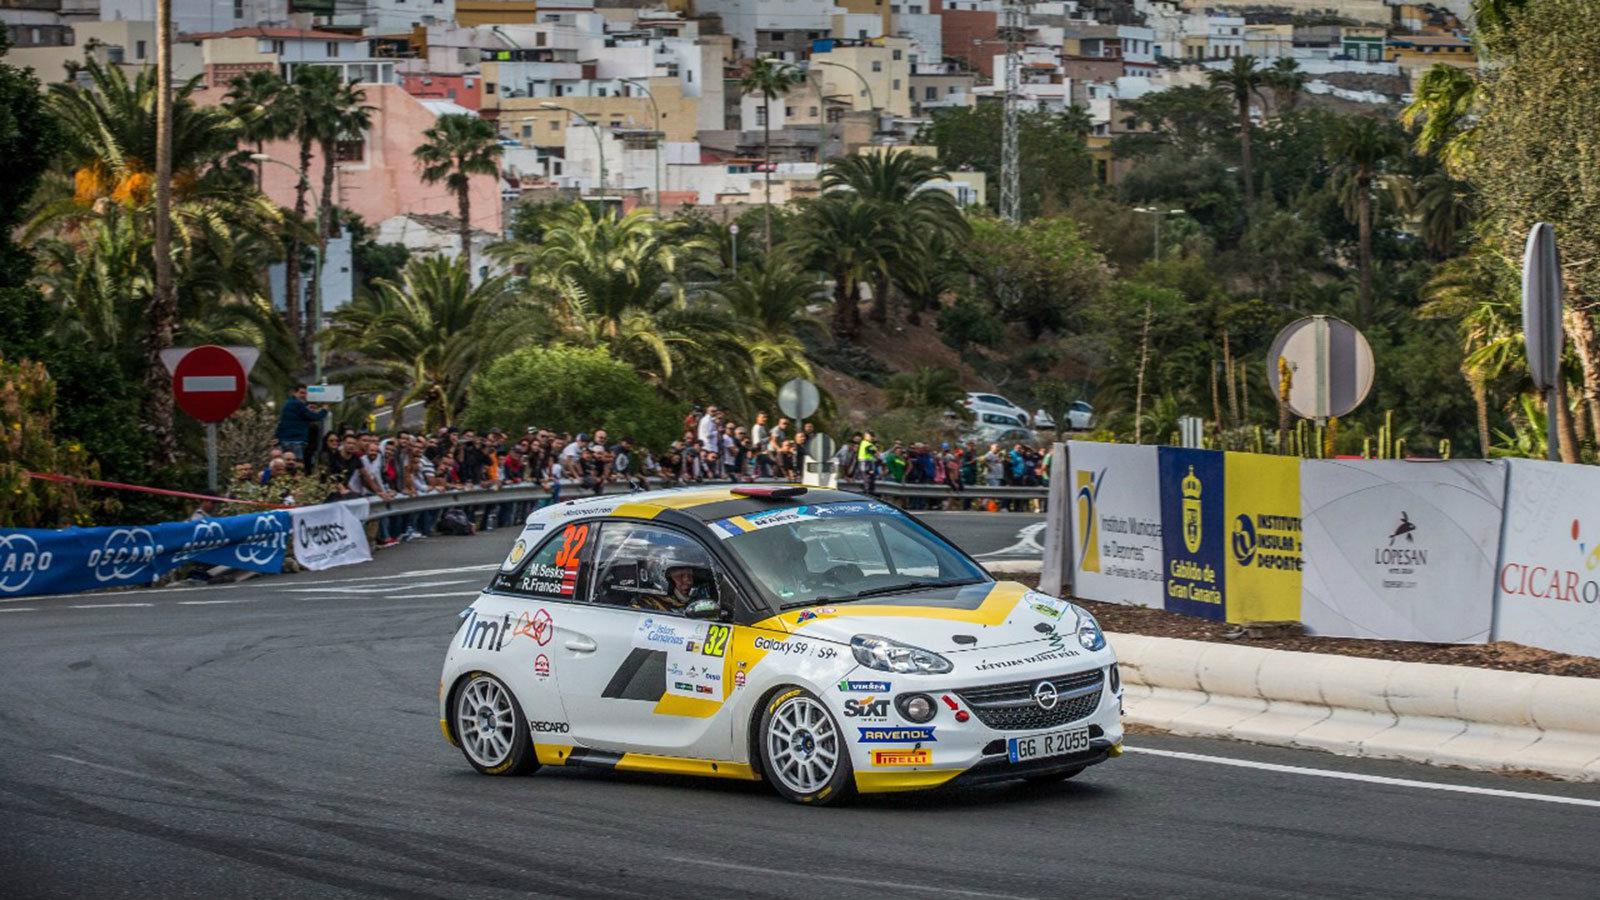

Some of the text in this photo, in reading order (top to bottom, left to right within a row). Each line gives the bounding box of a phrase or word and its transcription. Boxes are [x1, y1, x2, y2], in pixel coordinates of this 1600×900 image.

[1128, 517, 1163, 538] Municipa
[556, 523, 588, 568] 32
[1257, 534, 1294, 551] INSULAR
[0, 551, 53, 573] ARO
[1258, 553, 1302, 571] DEPORTE
[1375, 548, 1427, 565] LOPESAN
[530, 563, 565, 579] M.Sesks
[1170, 560, 1215, 583] Cabildo de
[521, 577, 561, 594] R.Francis
[1168, 579, 1221, 604] Gran Canaria
[1501, 563, 1600, 604] CICARo
[462, 612, 511, 652] lmt
[648, 631, 685, 645] Canarias
[704, 625, 729, 656] 32
[754, 636, 838, 659] Galaxy S9 S9+
[843, 697, 891, 717] SIXT
[530, 721, 570, 733] RECARO
[865, 730, 929, 740] RAVENOL
[1018, 730, 1088, 758] GG R 2055
[876, 751, 927, 765] PIRELLI
